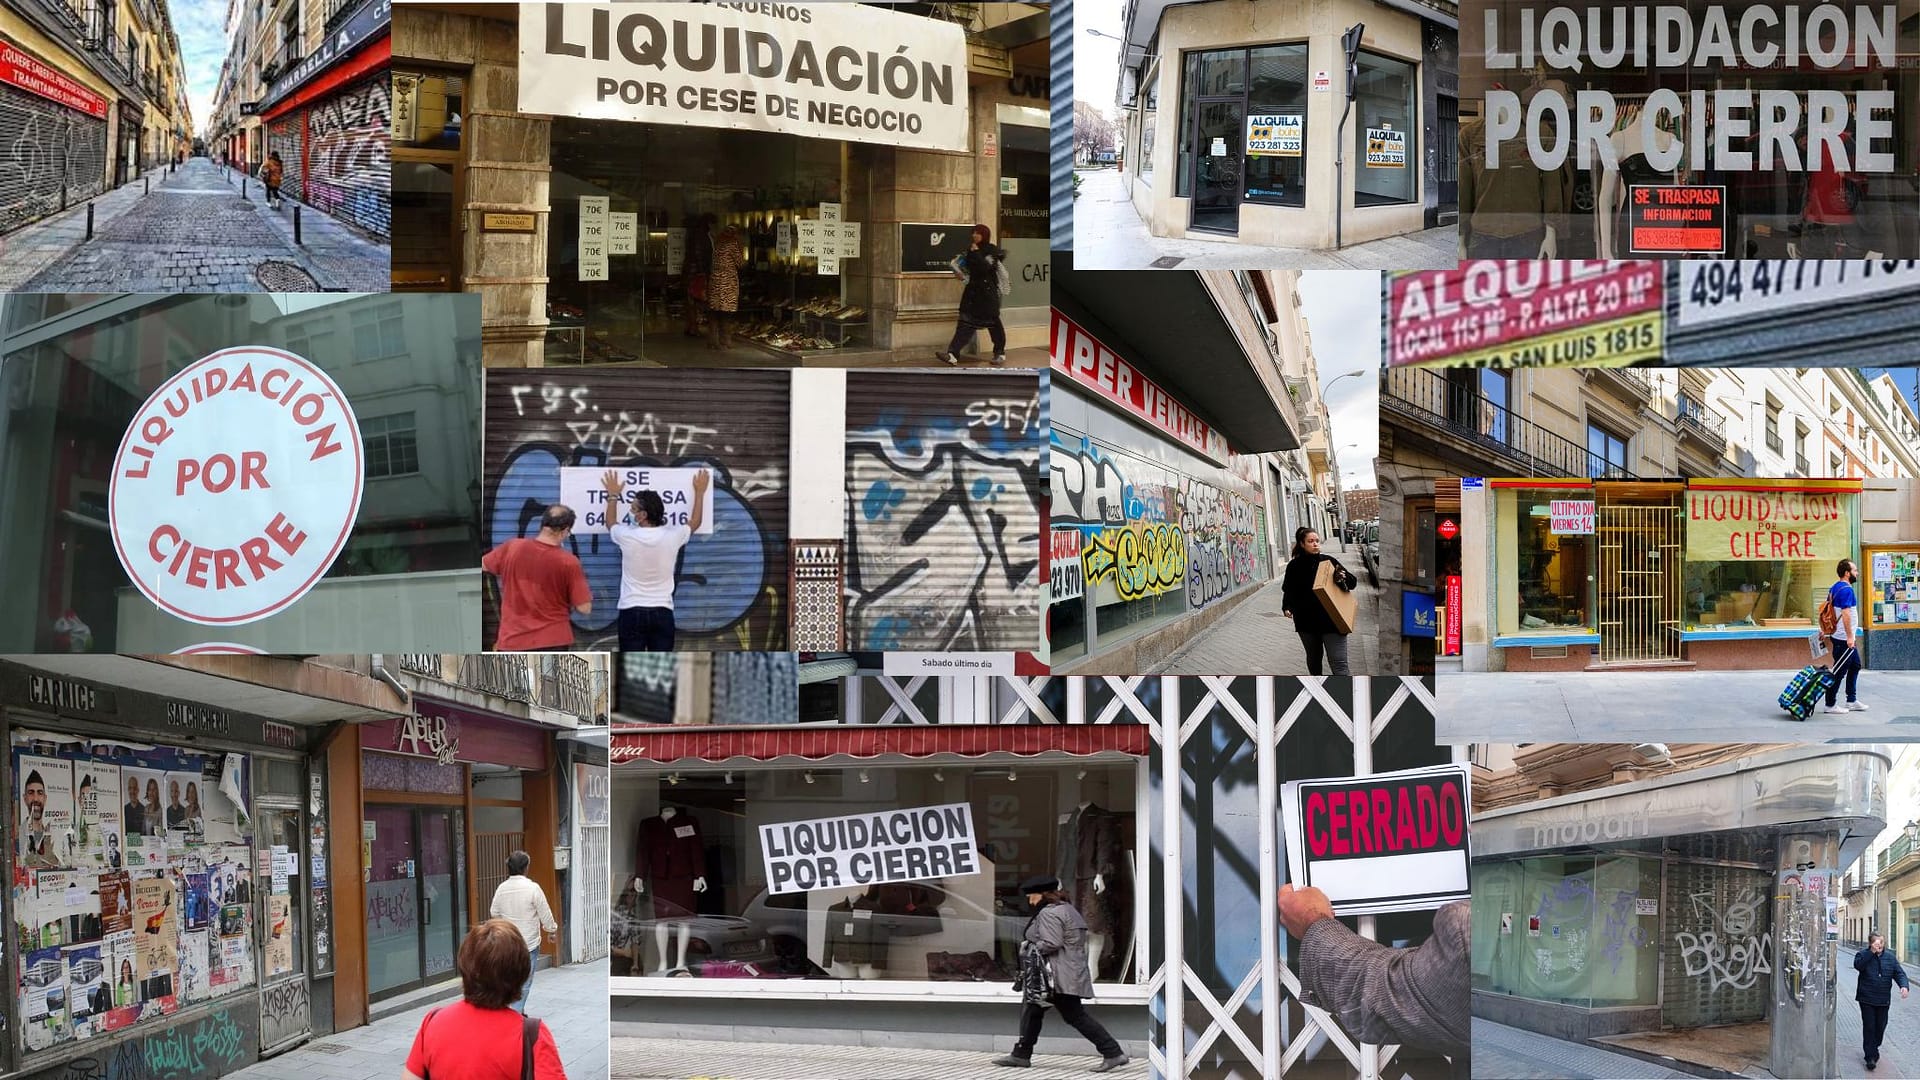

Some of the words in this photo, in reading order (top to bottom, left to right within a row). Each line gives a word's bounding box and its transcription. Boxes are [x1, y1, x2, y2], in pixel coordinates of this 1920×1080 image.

[1484, 0, 1897, 74] LIQUIDACIÓN
[545, 2, 955, 105] LIQUIDACIÓN
[597, 77, 666, 107] POR
[676, 85, 757, 115] CESE
[766, 94, 799, 121] DE
[807, 101, 923, 135] NEGOCIO
[1252, 117, 1299, 126] ALQUILA
[1369, 131, 1402, 141] ALQUILA
[1484, 89, 1619, 172] POR
[1641, 88, 1895, 172] CIERRE
[1249, 141, 1265, 149] 923
[1267, 141, 1280, 149] 281
[1282, 142, 1300, 150] 323
[1368, 154, 1380, 162] 923
[1391, 154, 1403, 162] 323
[1635, 189, 1650, 204] SE
[1657, 189, 1720, 204] TRASPASA
[586, 206, 602, 214] 70€
[1643, 209, 1712, 220] INFORMACION
[586, 227, 602, 235] 70€
[615, 222, 630, 230] 70€
[802, 229, 815, 237] 70€
[823, 229, 836, 237] 70€
[585, 248, 601, 256] 70€
[585, 269, 601, 277] 70€
[1691, 260, 1743, 306] 494
[1396, 325, 1447, 360] LOCAL
[1452, 316, 1480, 346] 115
[1539, 289, 1590, 327] ALTA
[1594, 281, 1620, 314] 20
[1510, 344, 1547, 368] SAN
[1553, 336, 1596, 365] LUIS
[1603, 324, 1654, 354] 1815
[1142, 378, 1203, 445] VENTAS
[125, 362, 343, 479] LIQUIDACIÓN
[176, 451, 271, 496] POR
[626, 471, 650, 486] SE
[1551, 501, 1581, 516] ULTIMO
[1583, 501, 1594, 516] DIA
[1691, 494, 1839, 522] LIQUIDACION
[1551, 519, 1580, 530] VIERNES
[1581, 517, 1592, 532] 14
[1758, 522, 1777, 530] POR
[148, 511, 308, 590] CIERRE
[1730, 531, 1817, 559] CIERRE
[1065, 564, 1080, 596] 970
[922, 658, 953, 667] Sabado
[954, 658, 979, 668] último
[1306, 781, 1462, 857] CERRADO
[765, 807, 968, 857] LIQUIDACION
[770, 856, 840, 892] POR
[850, 842, 974, 884] CIERRE
